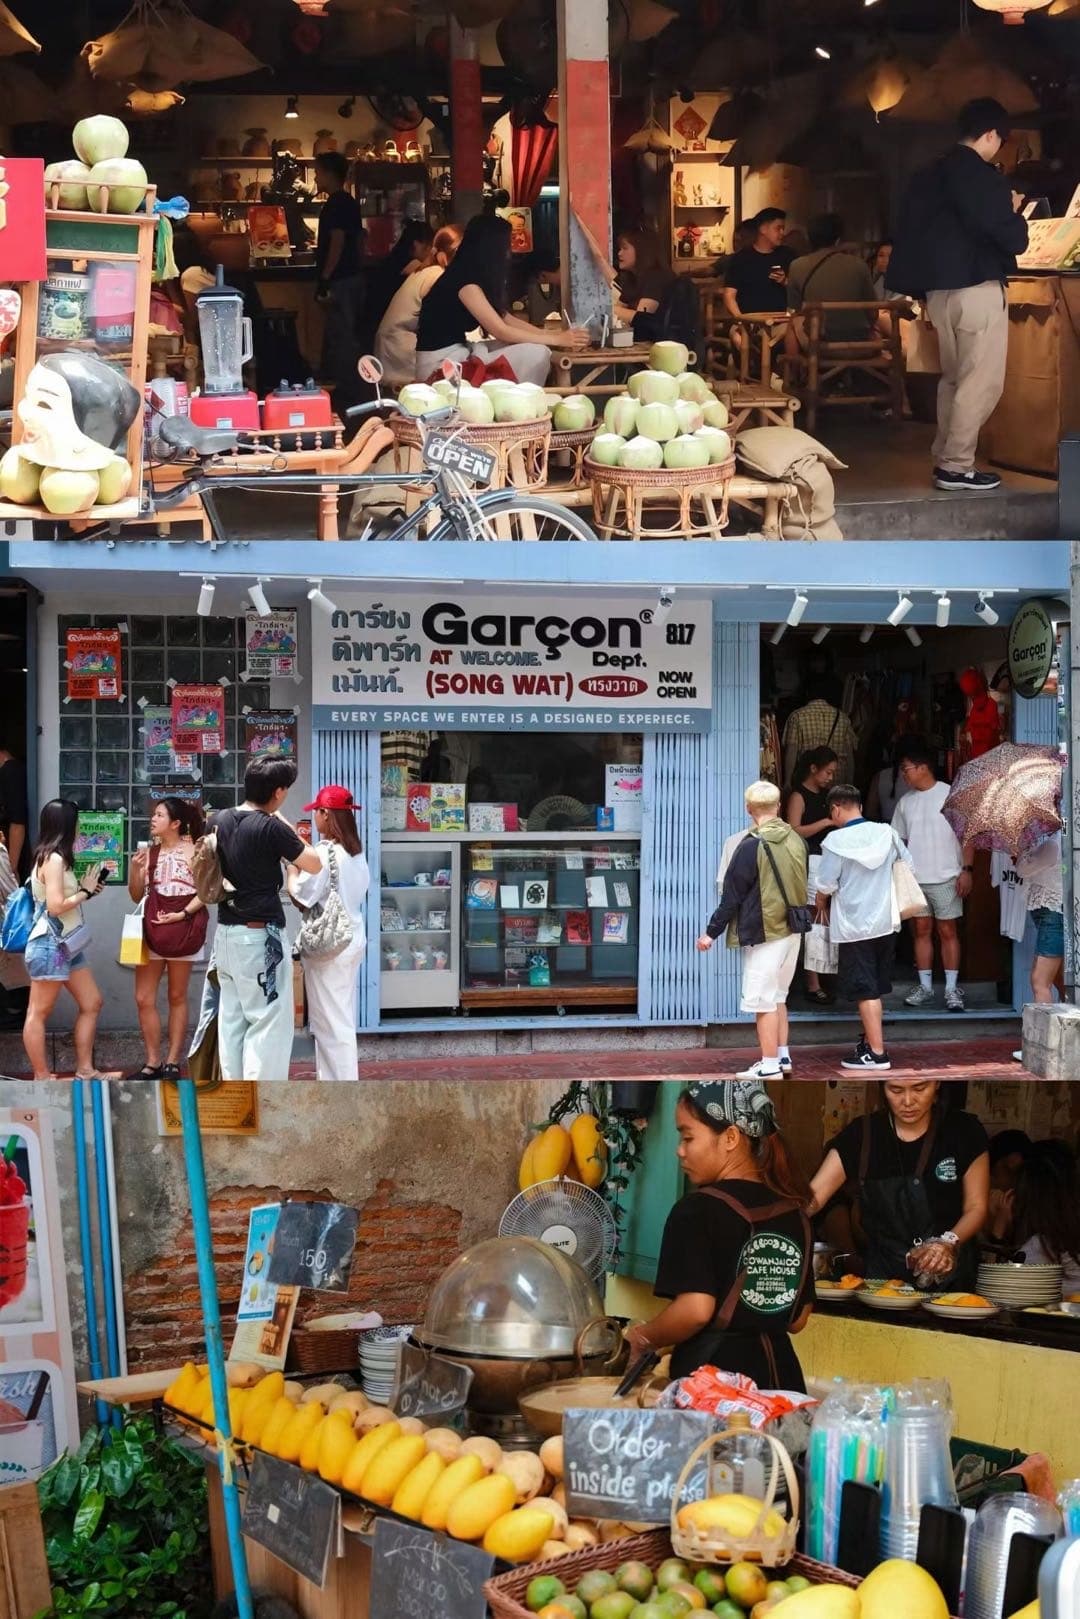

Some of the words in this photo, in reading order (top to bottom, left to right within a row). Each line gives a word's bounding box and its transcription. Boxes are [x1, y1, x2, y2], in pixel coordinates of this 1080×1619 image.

[427, 443, 490, 478] OPEN
[666, 623, 696, 645] 817
[430, 650, 453, 665] AT
[460, 650, 542, 667] WELCOME.
[592, 651, 647, 671] Dept.
[426, 670, 504, 699] (SONG
[512, 672, 573, 702] WAT)
[658, 671, 693, 684] NOW
[331, 711, 377, 722] EVERY
[383, 711, 429, 722] SPACE
[434, 712, 455, 723] WE
[461, 713, 505, 723] ENTER
[511, 713, 524, 724] IS
[530, 713, 539, 724] A
[544, 713, 613, 724] DESIGNED
[618, 714, 695, 725] EXPERIECE.
[299, 1248, 327, 1270] 150
[746, 1266, 767, 1275] CAFE
[769, 1266, 797, 1276] HOUSE
[588, 1419, 671, 1459] Order
[569, 1461, 636, 1498] inside
